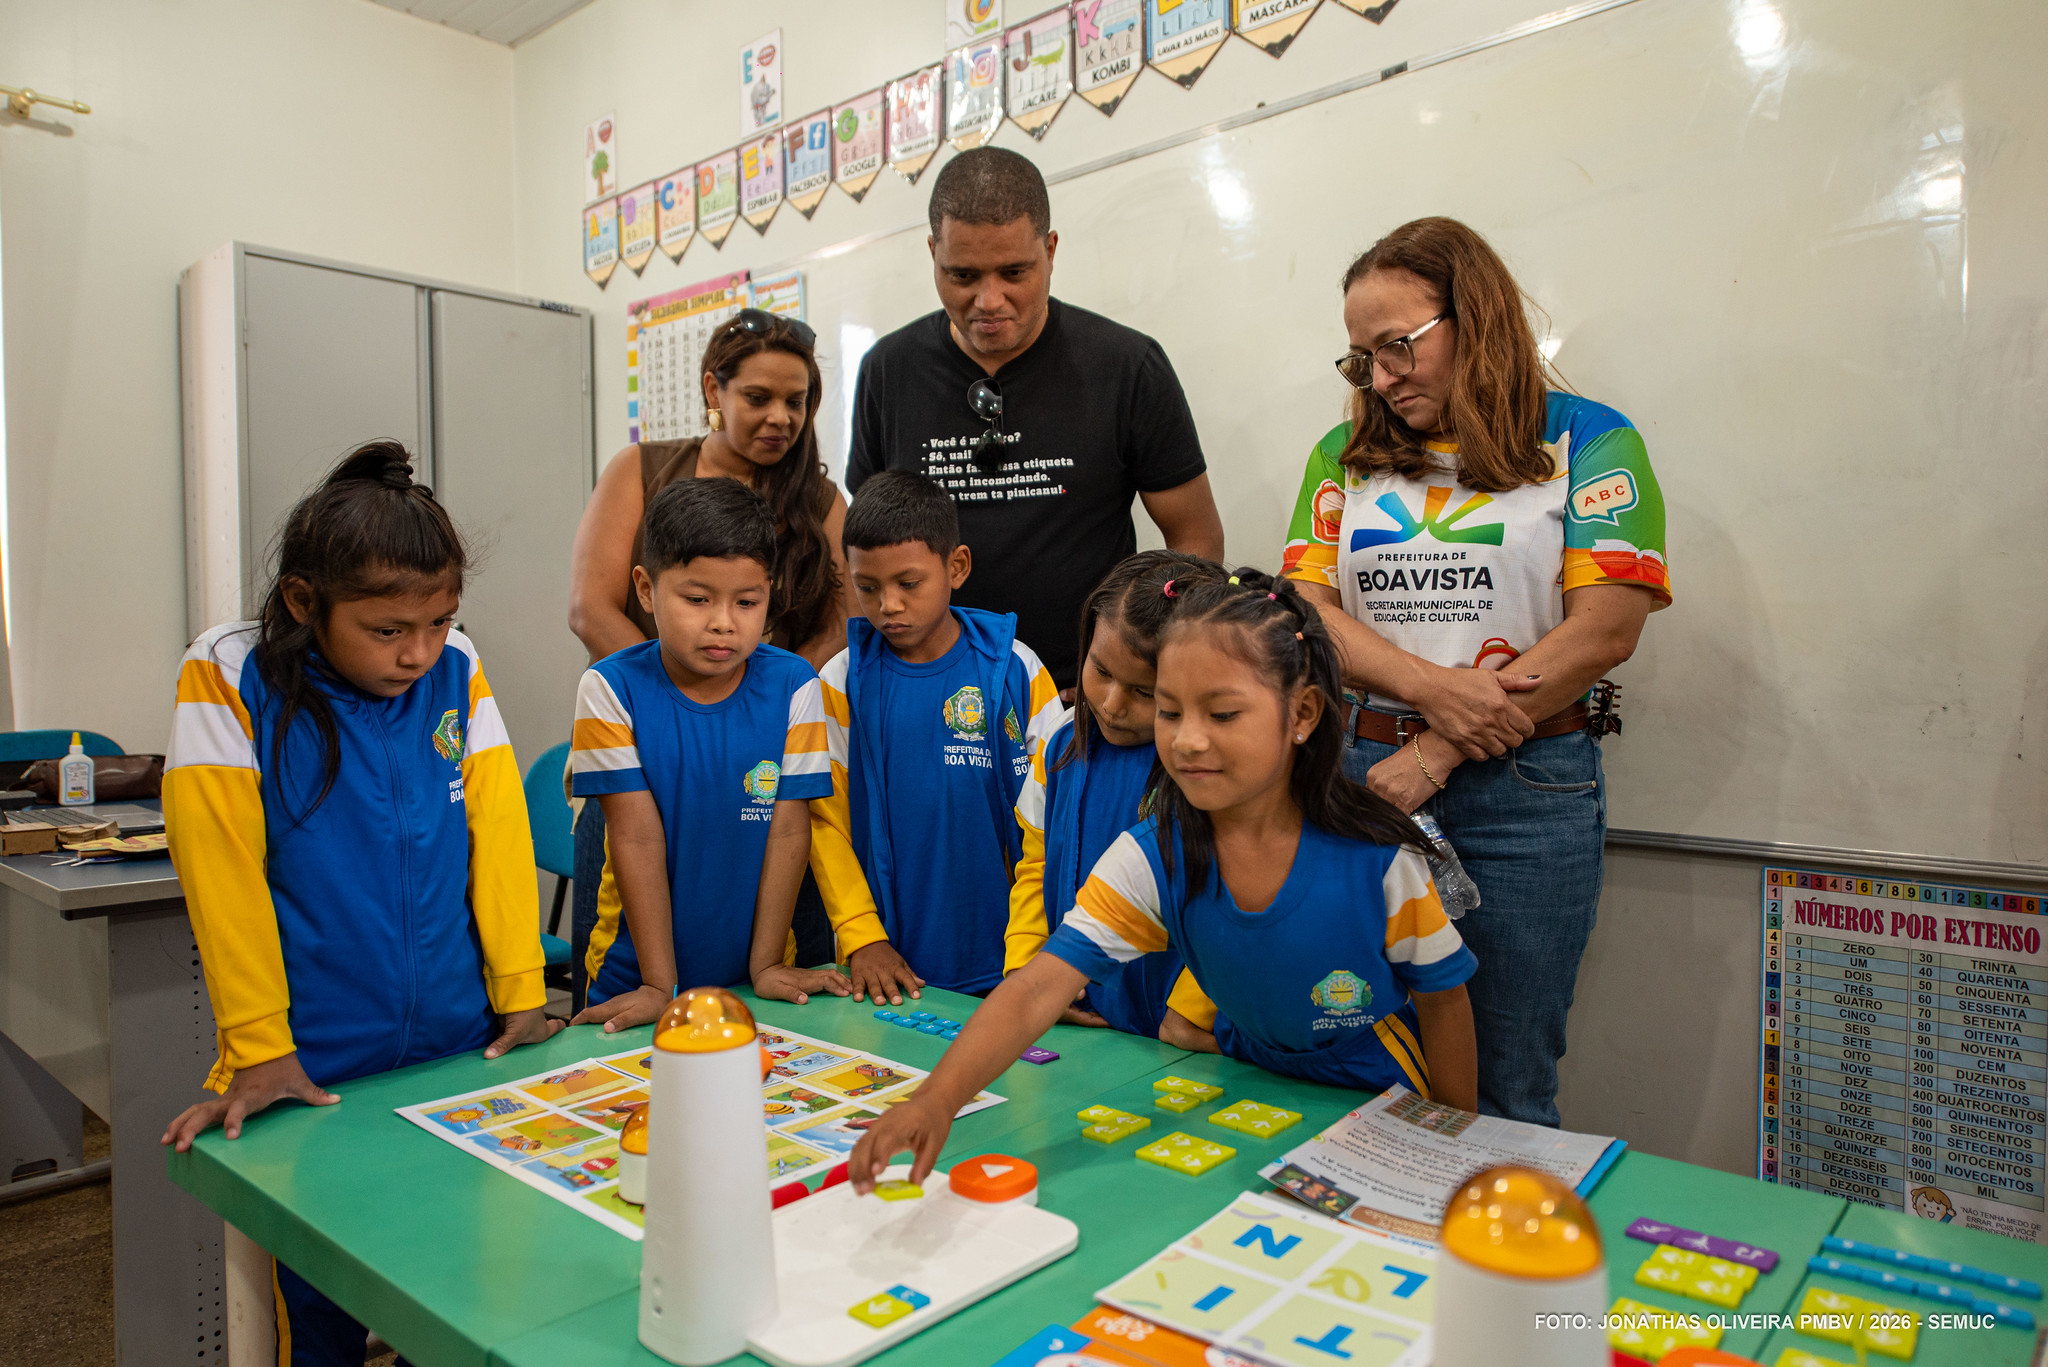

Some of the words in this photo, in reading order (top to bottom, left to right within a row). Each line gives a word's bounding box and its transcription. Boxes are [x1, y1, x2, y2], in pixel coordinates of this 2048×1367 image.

[1093, 58, 1130, 82] KOMBI
[843, 157, 876, 177] GOOGLE
[790, 174, 827, 193] FACEBOOK
[930, 437, 956, 448] Você
[960, 436, 966, 445] é
[928, 465, 962, 475] Então
[1023, 457, 1073, 469] etiqueta
[949, 450, 972, 459] uai!
[948, 479, 965, 487] me
[970, 472, 1050, 486] incomodando.
[959, 491, 987, 500] trem
[991, 490, 1003, 499] ta
[1007, 485, 1062, 500] pinicanu!
[1378, 552, 1448, 561] PREFEITURA
[1452, 552, 1466, 560] DE
[1366, 601, 1412, 610] SECRETARIA
[1414, 600, 1475, 610] MUNICIPAL
[1478, 600, 1493, 609] DE
[1374, 611, 1417, 624] EDUCAÇÃO
[1420, 613, 1425, 622] E
[1428, 613, 1480, 622] CULTURA
[944, 745, 983, 756] PREFEITURA
[944, 754, 965, 765] BOA
[969, 755, 992, 768] VISTA
[1795, 897, 1884, 935] NÚMEROS
[1890, 911, 1937, 941] POR
[1944, 918, 2040, 954] EXTENSO
[1796, 937, 1801, 945] 0
[1843, 943, 1875, 955] ZERO
[1796, 950, 1801, 958] 1
[1850, 957, 1868, 968] UM
[1919, 953, 1933, 963] 30
[1970, 959, 2017, 975] TRINTA
[1796, 962, 1801, 971] 2
[1844, 969, 1872, 982] DOIS
[1919, 967, 1933, 977] 40
[1957, 972, 2029, 991] QUARENTA
[1795, 975, 1801, 983] 3
[1843, 983, 1874, 997] TRÊS
[1919, 980, 1932, 991] 50
[1955, 986, 2031, 1005] CINQUENTA
[1795, 988, 1801, 997] 4
[1834, 994, 1883, 1010] QUATRO
[1918, 994, 1932, 1005] 60
[1959, 1000, 2027, 1019] SESSENTA
[1340, 1019, 1374, 1027] VISTA
[1794, 1001, 1800, 1009] 5
[1839, 1009, 1876, 1023] CINCO
[1918, 1008, 1931, 1018] 70
[1963, 1015, 2022, 1033] SETENTA
[1794, 1014, 1800, 1022] 6
[1844, 1023, 1871, 1035] SEIS
[1917, 1022, 1931, 1032] 80
[1964, 1030, 2020, 1047] OITENTA
[1794, 1027, 1800, 1035] 7
[1842, 1036, 1872, 1049] SETE
[1917, 1036, 1931, 1046] 90
[1960, 1043, 2022, 1061] NOVENTA
[1794, 1040, 1800, 1048] 8
[1843, 1050, 1871, 1062] OITO
[1914, 1049, 1934, 1060] 100
[1977, 1060, 2006, 1073] CEM
[1794, 1053, 1800, 1061] 9
[1840, 1062, 1873, 1076] NOVE
[1791, 1066, 1802, 1075] 10
[1845, 1077, 1868, 1089] DEZ
[1913, 1062, 1934, 1074] 200
[1956, 1070, 2026, 1091] DUZENTOS
[1791, 1079, 1801, 1088] 11
[1840, 1089, 1872, 1103] ONZE
[1913, 1076, 1933, 1088] 300
[1953, 1083, 2030, 1105] TREZENTOS
[1790, 1092, 1801, 1101] 12
[1840, 1102, 1872, 1117] DOZE
[1912, 1090, 1933, 1102] 400
[1938, 1094, 2045, 1123] QUATROCENTOS
[1790, 1104, 1801, 1114] 13
[1838, 1114, 1874, 1131] TREZE
[1912, 1103, 1933, 1115] 500
[1948, 1110, 2033, 1135] QUINHENTOS
[1790, 1117, 1801, 1127] 14
[1825, 1125, 1887, 1146] QUATORZE
[1912, 1117, 1933, 1129] 600
[1950, 1124, 2032, 1149] SEISCENTOS
[1790, 1130, 1801, 1140] 15
[1834, 1140, 1877, 1158] QUINZE
[1912, 1130, 1932, 1142] 700
[1947, 1138, 2033, 1164] SETECENTOS
[1789, 1143, 1801, 1153] 16
[1824, 1151, 1887, 1174] DEZESSEIS
[1911, 1144, 1932, 1156] 800
[1948, 1151, 2032, 1178] OITOCENTOS
[1789, 1156, 1800, 1166] 17
[1821, 1163, 1889, 1188] DEZESSETE
[1789, 1169, 1800, 1178] 18
[1830, 1178, 1880, 1198] DEZOITO
[1911, 1157, 1932, 1170] 900
[1945, 1165, 2034, 1192] NOVECENTOS
[1908, 1170, 1935, 1184] 1000
[1977, 1186, 1999, 1199] MIL
[1980, 1211, 2005, 1222] TENHA
[2006, 1218, 2029, 1228] MEDO
[2031, 1223, 2041, 1231] DE
[1996, 1223, 2013, 1232] POIS
[2016, 1227, 2037, 1237] VOCÊ
[1293, 1324, 1355, 1360] T
